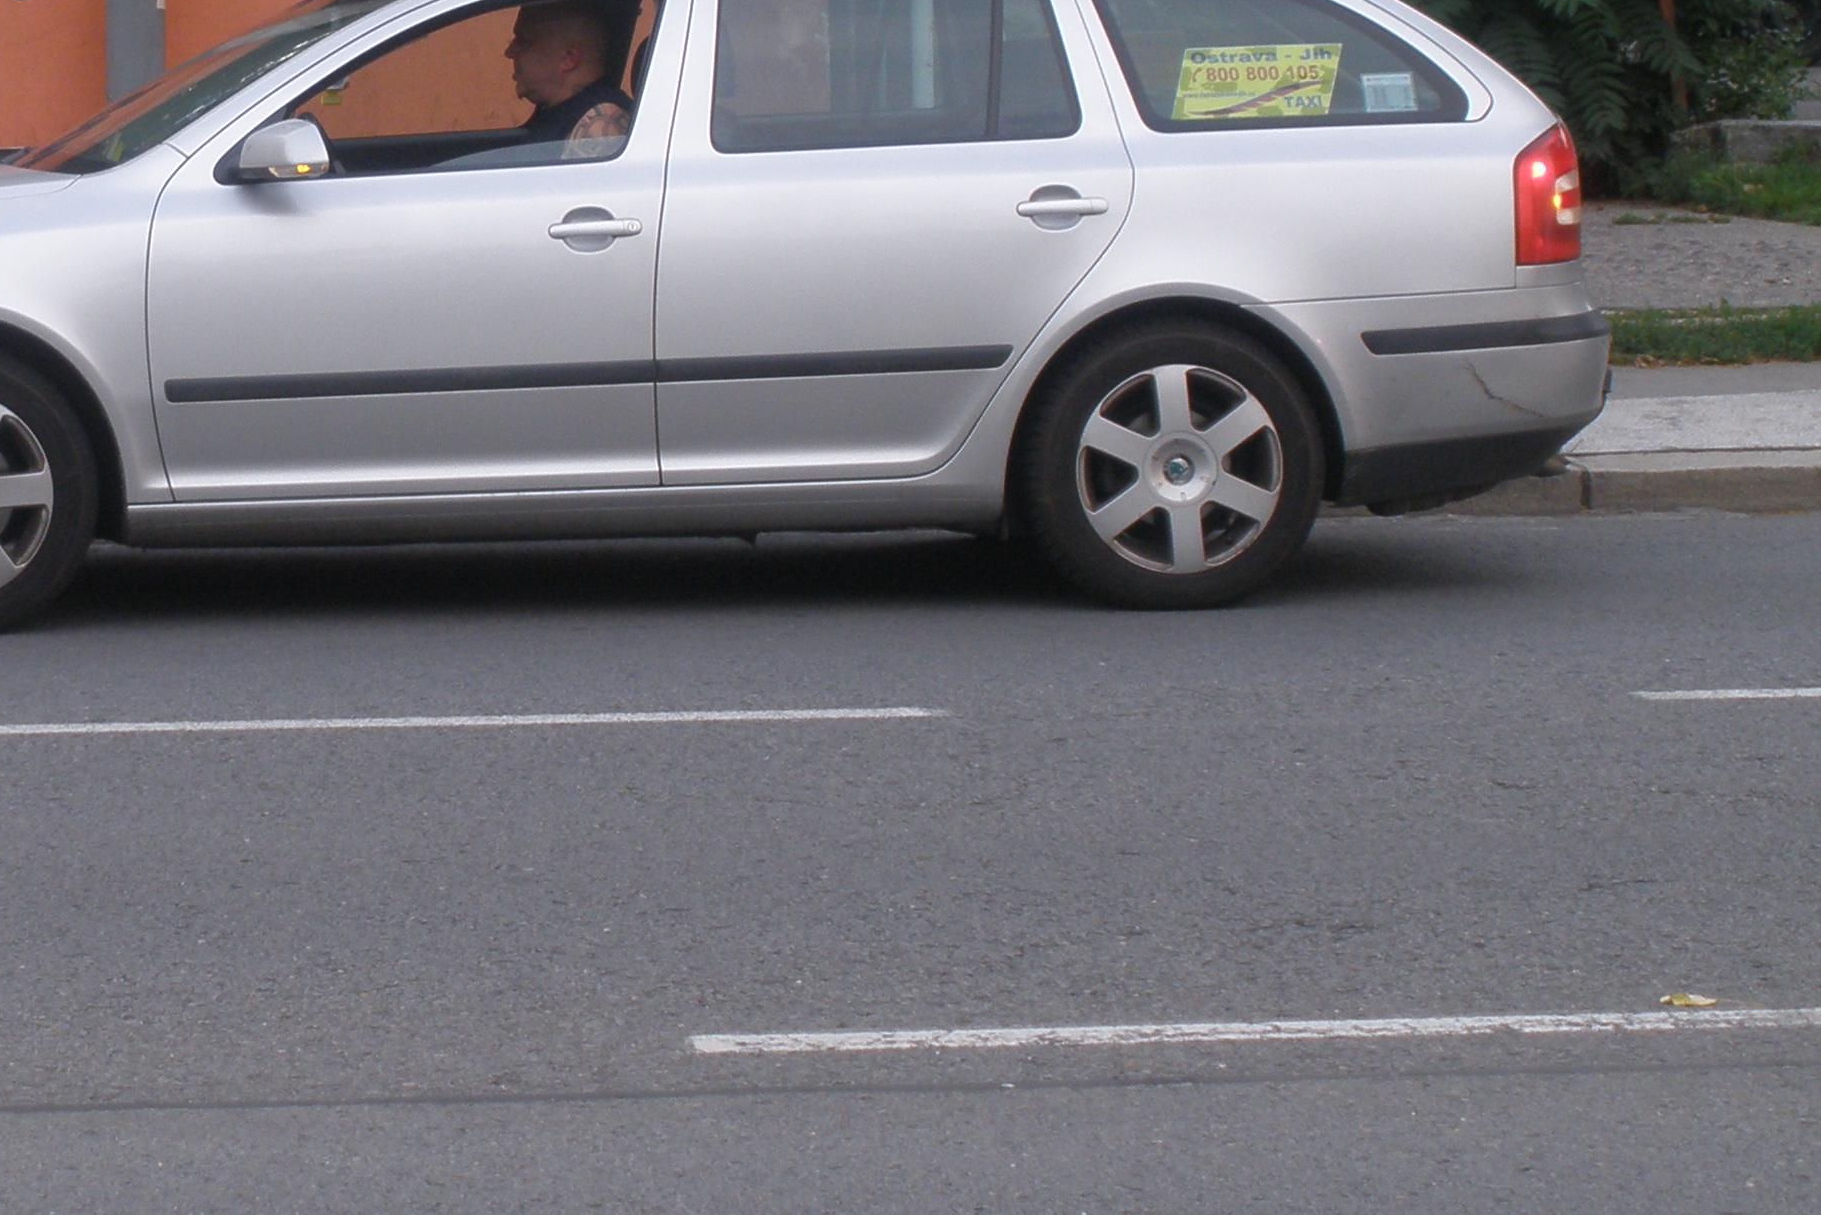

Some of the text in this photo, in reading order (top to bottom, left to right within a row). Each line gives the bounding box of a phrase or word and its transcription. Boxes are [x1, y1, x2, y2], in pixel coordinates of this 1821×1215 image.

[1190, 50, 1278, 64] Ostrava
[1206, 64, 1319, 82] 800 800 105
[1283, 95, 1323, 108] TAXI
